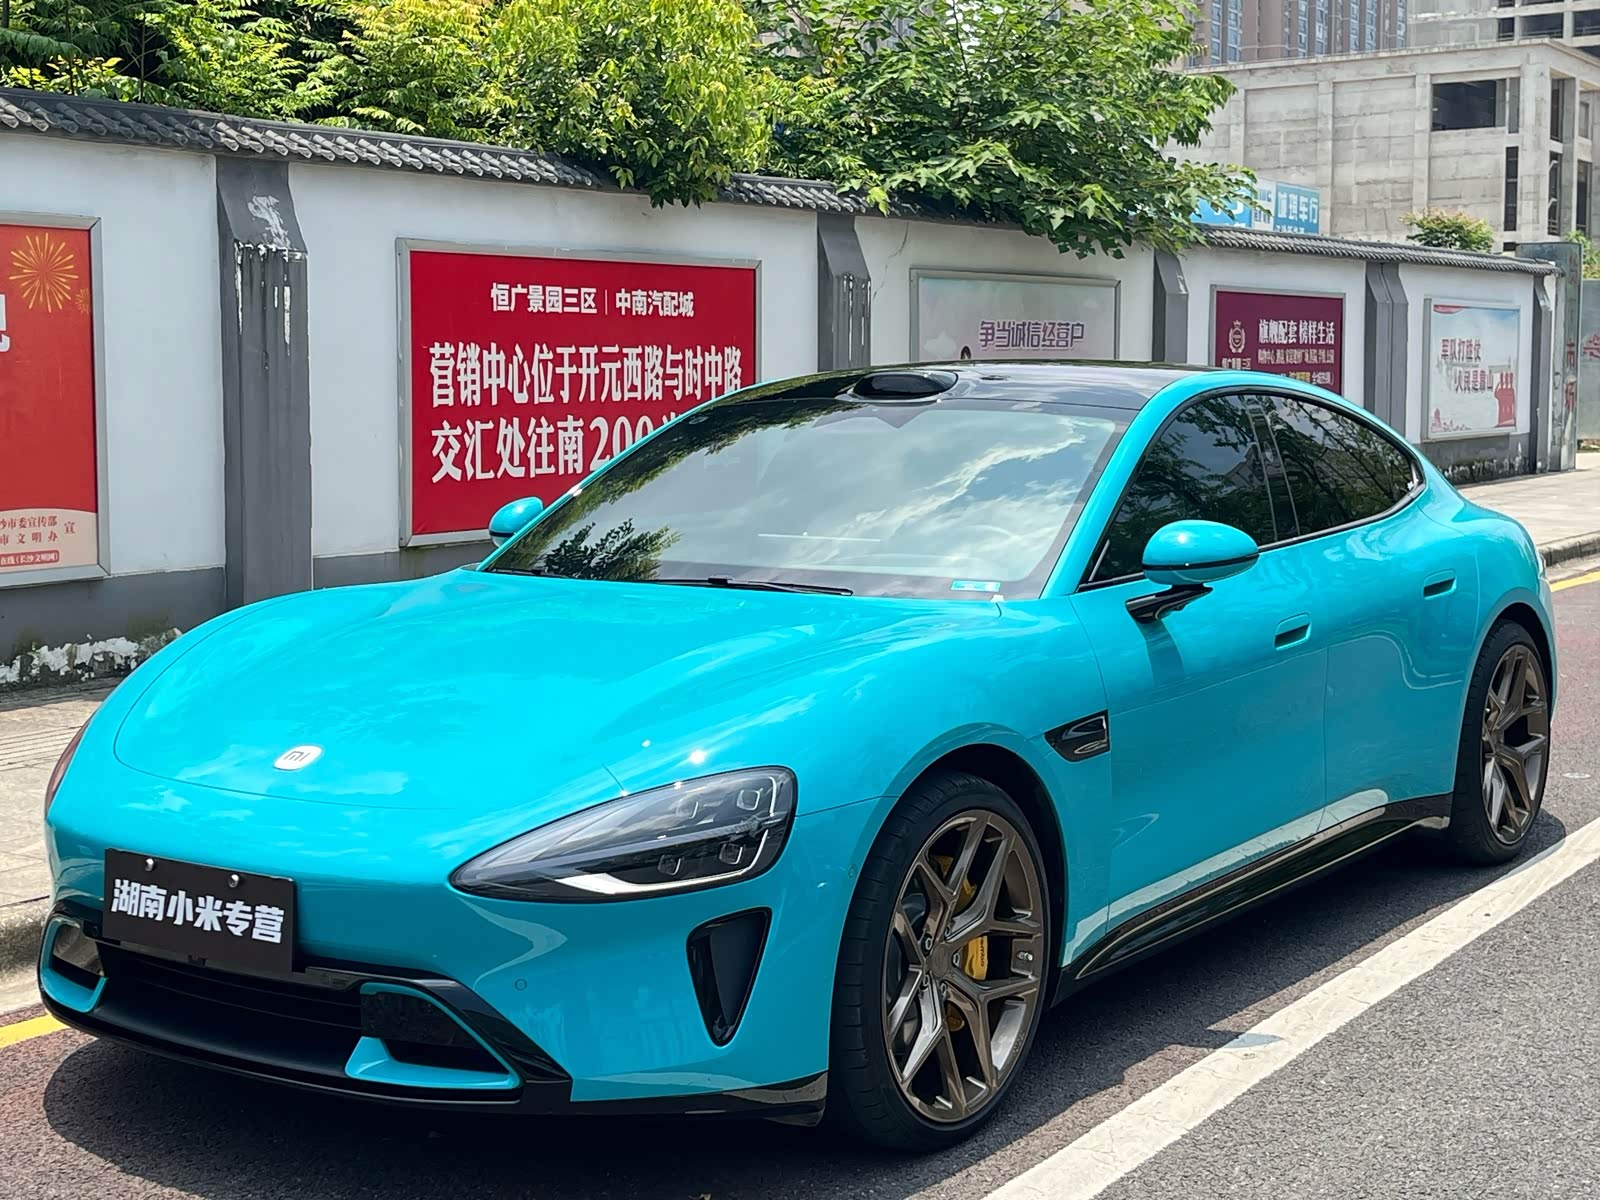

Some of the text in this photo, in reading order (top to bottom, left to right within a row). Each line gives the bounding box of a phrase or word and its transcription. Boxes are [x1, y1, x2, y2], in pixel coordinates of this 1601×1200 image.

[490, 282, 695, 318] 恒广景园三区 中南汽配城
[979, 320, 1085, 348] 争当诚信经营户
[1258, 319, 1335, 345] 旗舰配套 榜样生活
[429, 341, 742, 408] 营销中心位于开元西路与时中路
[431, 412, 682, 483] 交汇处往南20
[64, 521, 76, 534] 宣
[111, 878, 285, 944] 湖南小米专营
